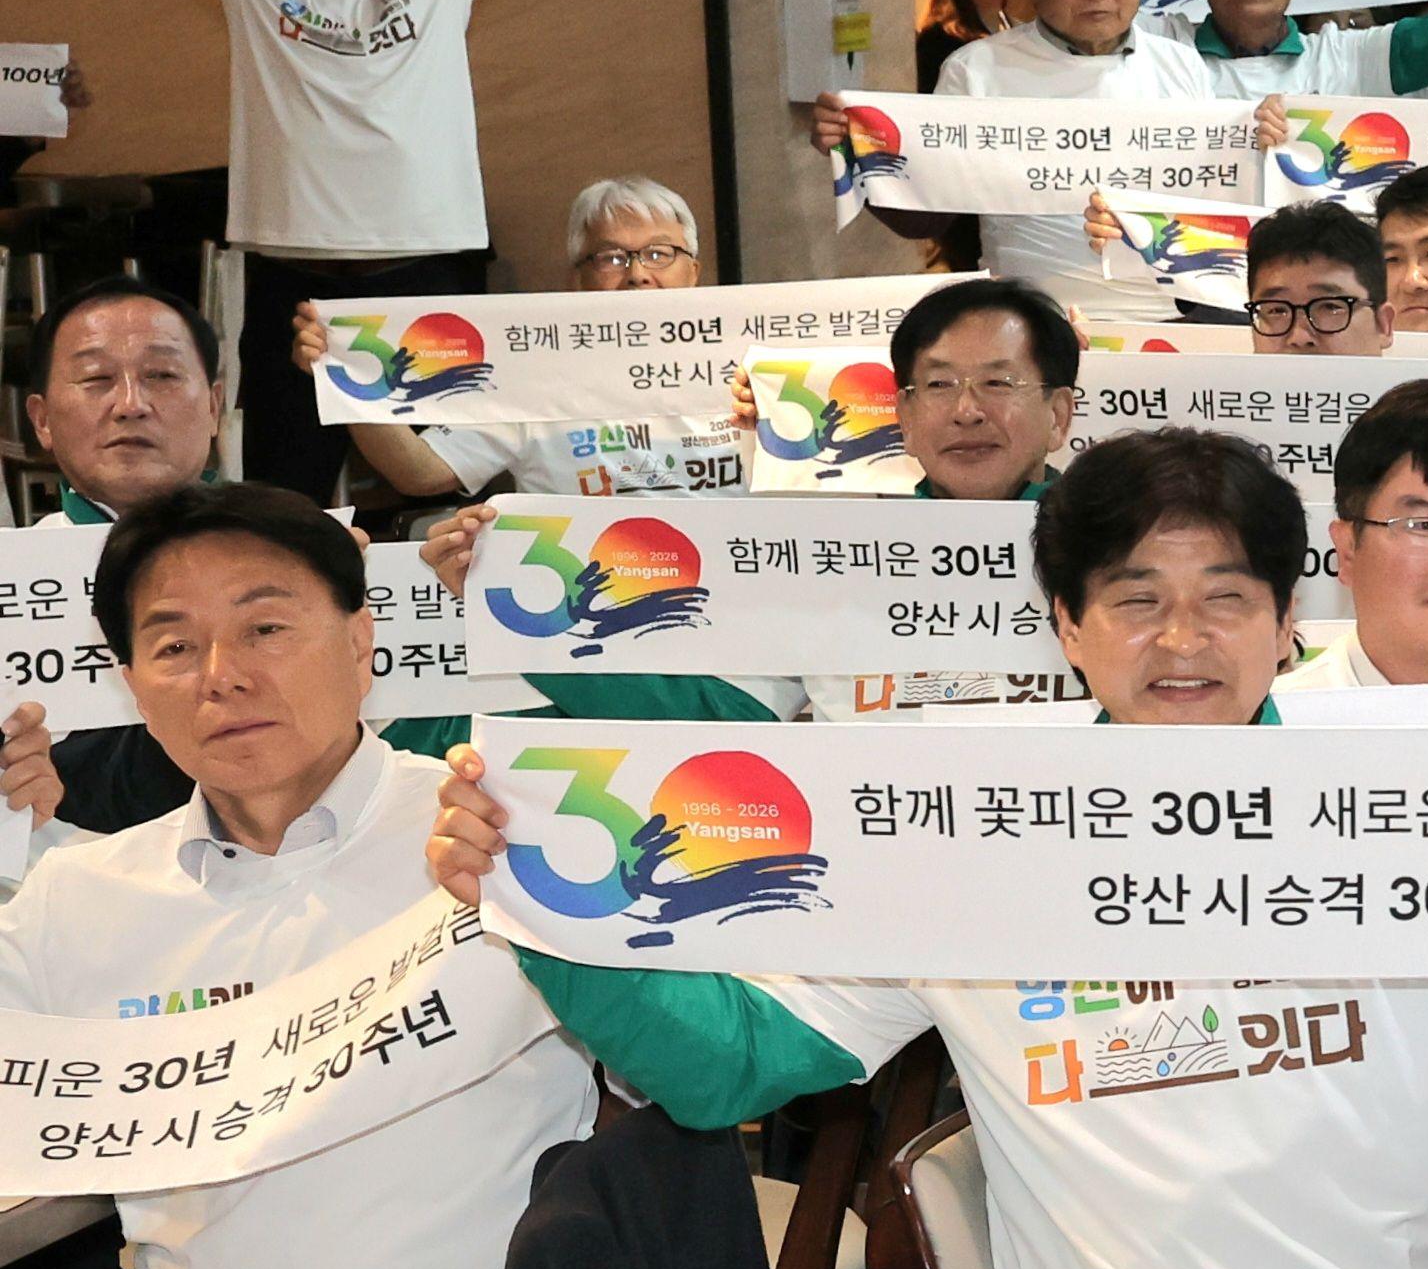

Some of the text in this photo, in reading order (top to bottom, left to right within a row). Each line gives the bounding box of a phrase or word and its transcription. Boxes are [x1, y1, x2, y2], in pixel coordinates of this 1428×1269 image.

[727, 538, 1016, 578] 함께 꽃피운 30년
[683, 803, 779, 817] 1996 2026
[851, 784, 954, 837] 함께
[975, 786, 1132, 839] 꽃피운
[1152, 787, 1272, 839] 30년
[683, 822, 780, 843] Yangsan
[119, 1040, 235, 1093] 30년
